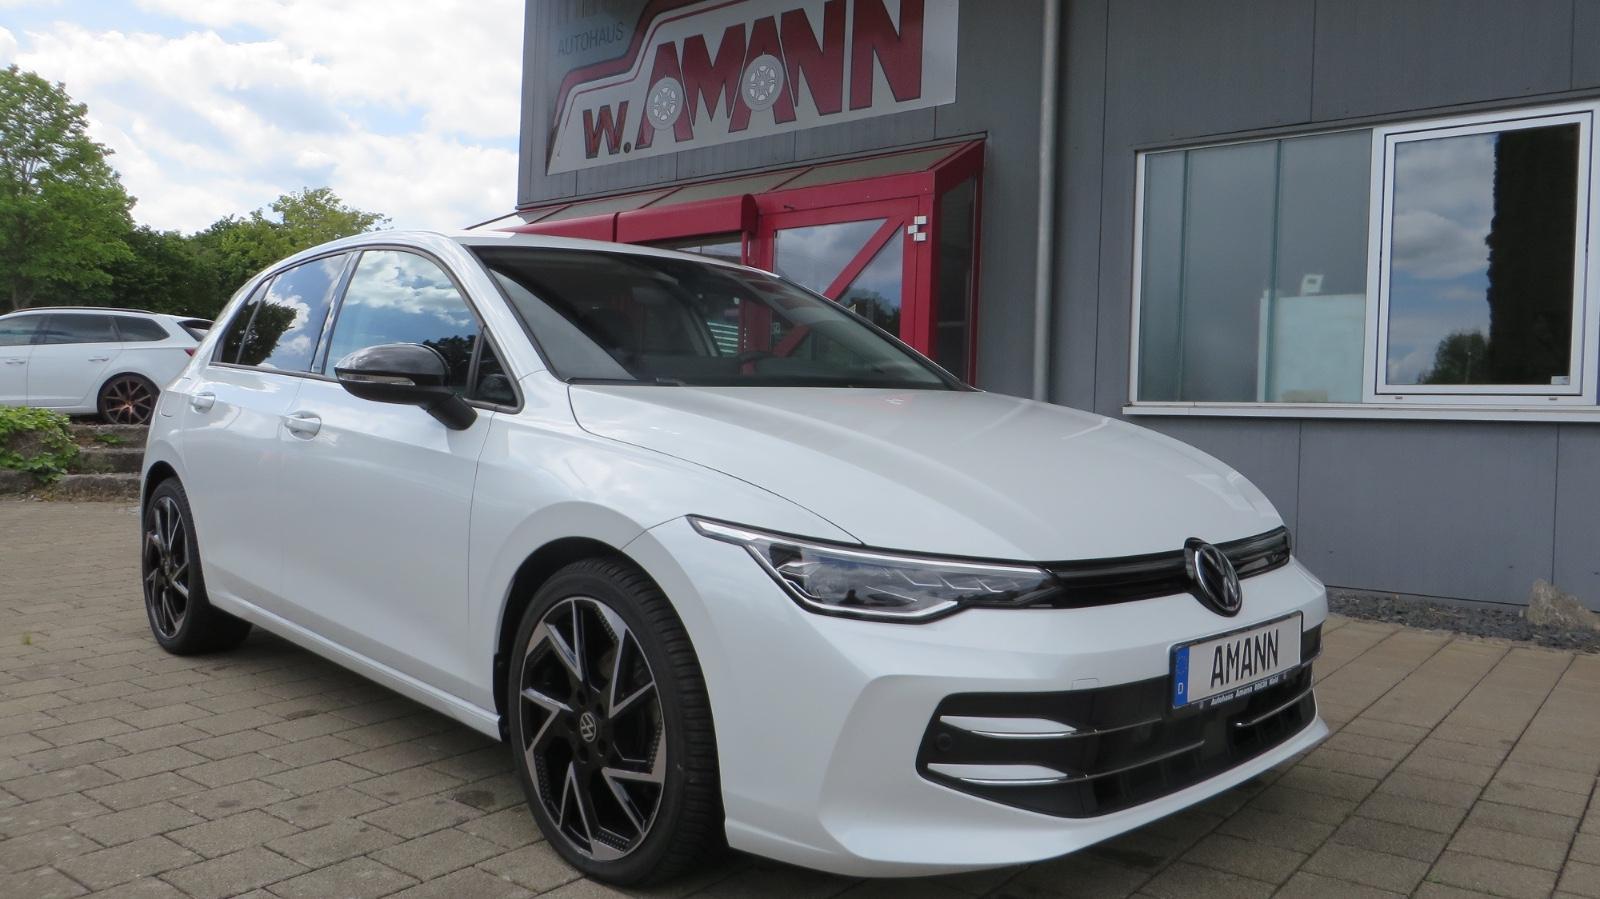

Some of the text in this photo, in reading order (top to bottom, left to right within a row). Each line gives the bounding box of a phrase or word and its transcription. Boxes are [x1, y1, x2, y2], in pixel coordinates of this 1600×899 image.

[558, 22, 625, 55] AUTOHAUS
[1210, 629, 1279, 688] AMANN
[1177, 682, 1184, 695] D
